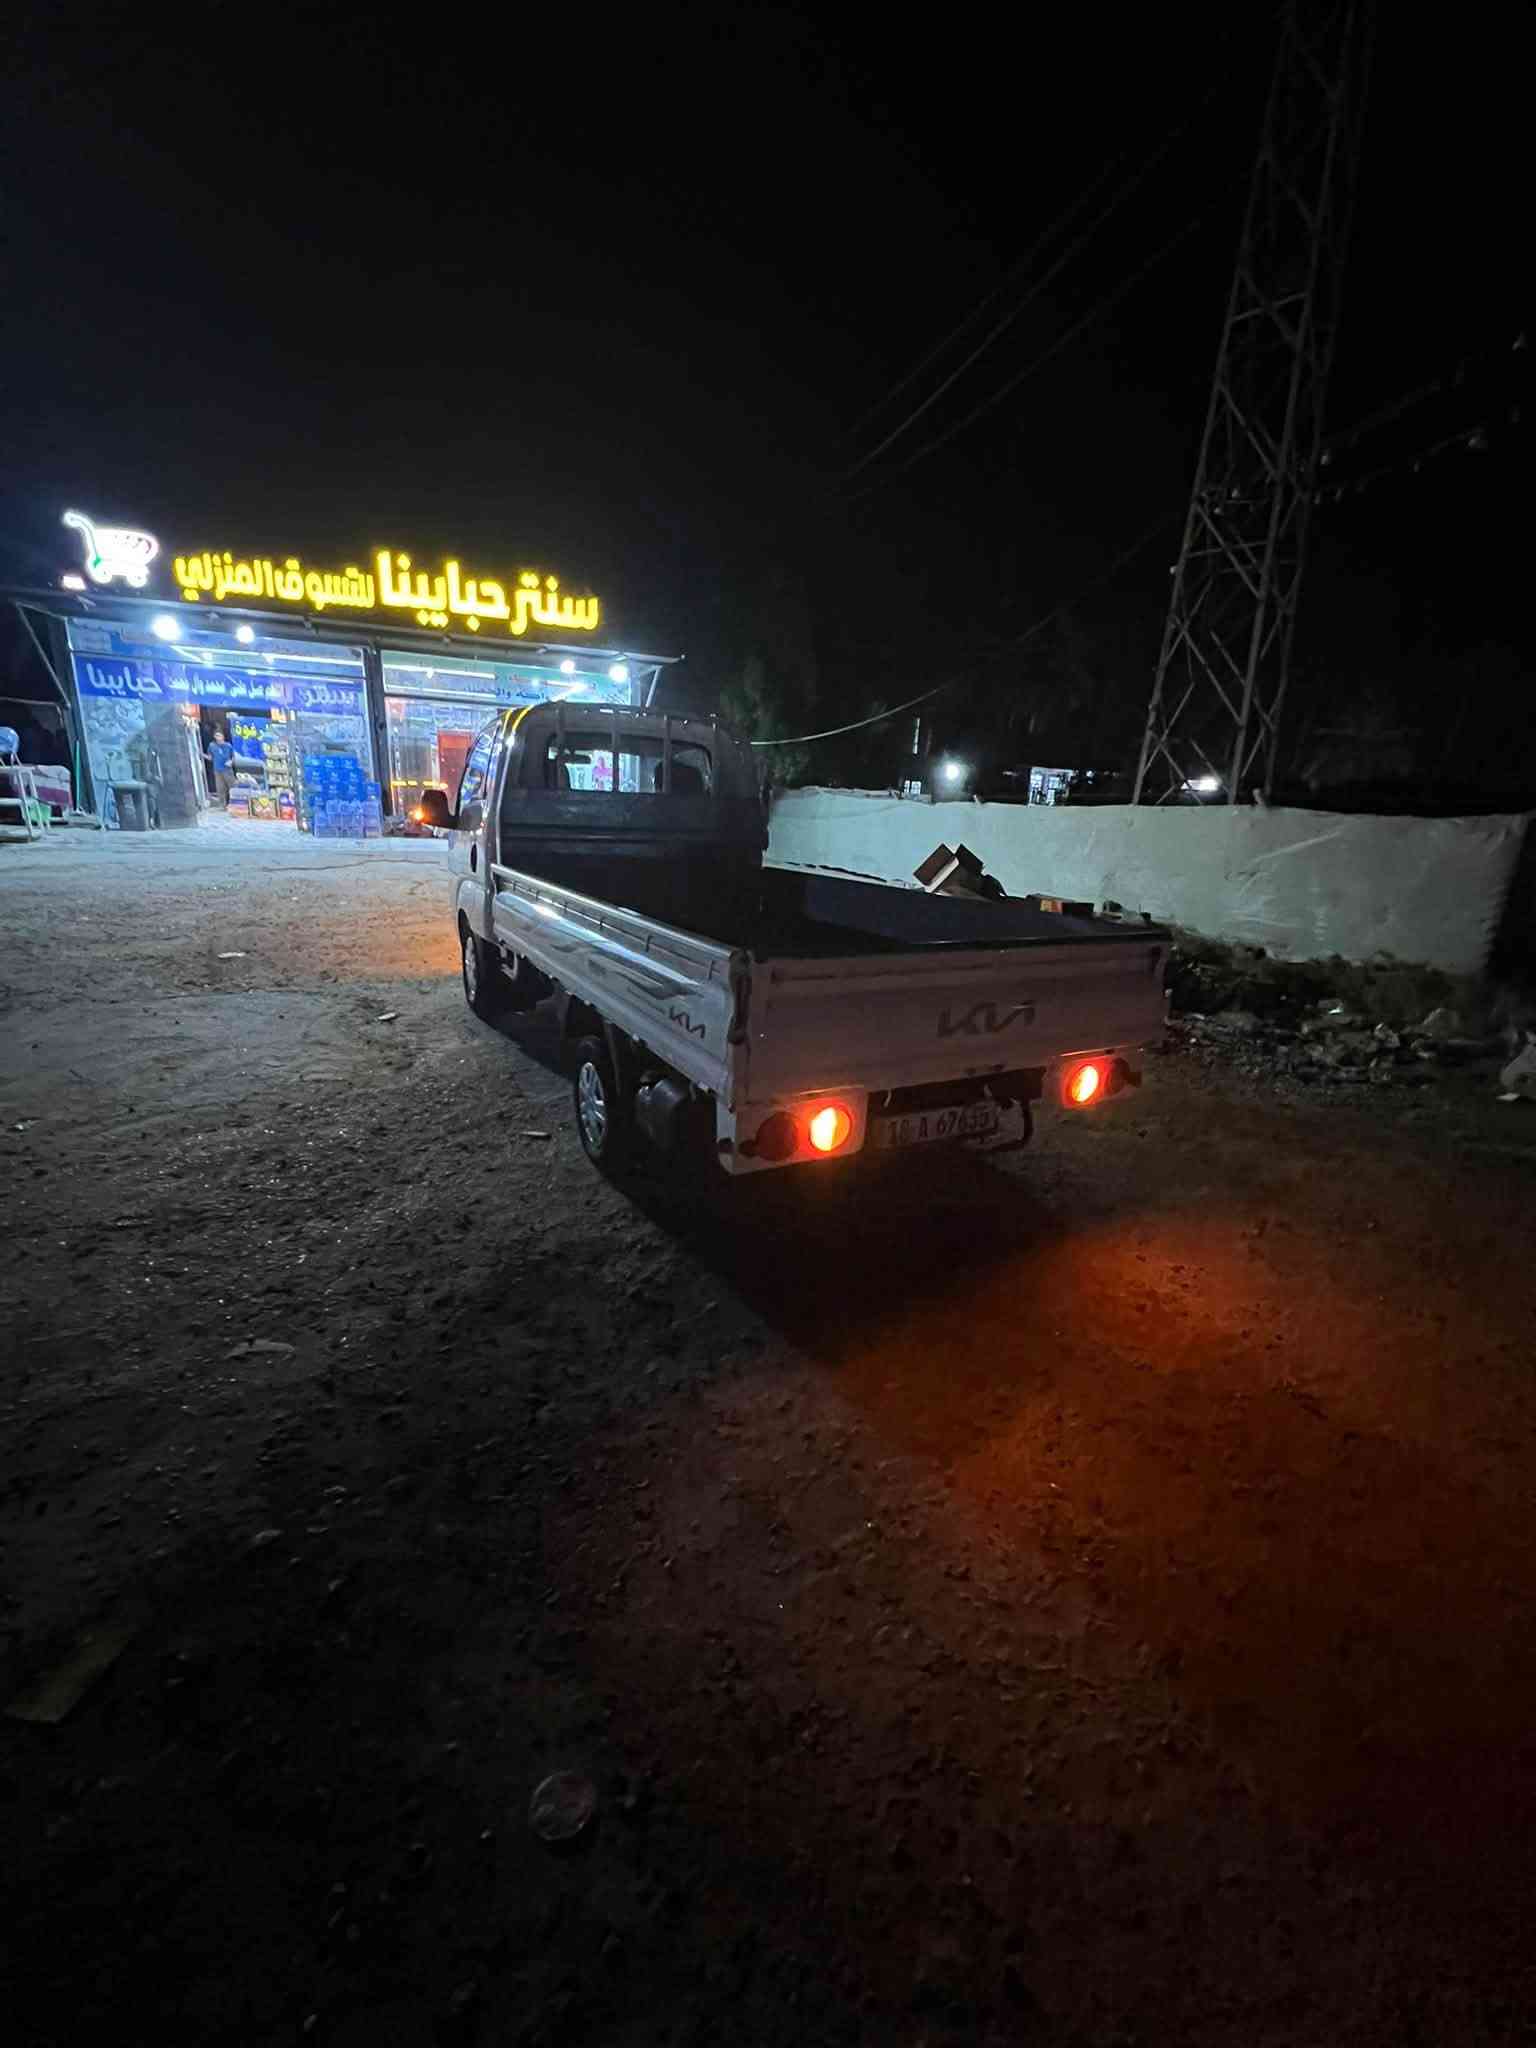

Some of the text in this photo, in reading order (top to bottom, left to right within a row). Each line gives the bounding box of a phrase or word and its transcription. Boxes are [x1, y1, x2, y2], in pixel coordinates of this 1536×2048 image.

[174, 550, 599, 635] سنتر حبايبنا للتسوق المنزلي
[86, 663, 163, 699] حبايبنا
